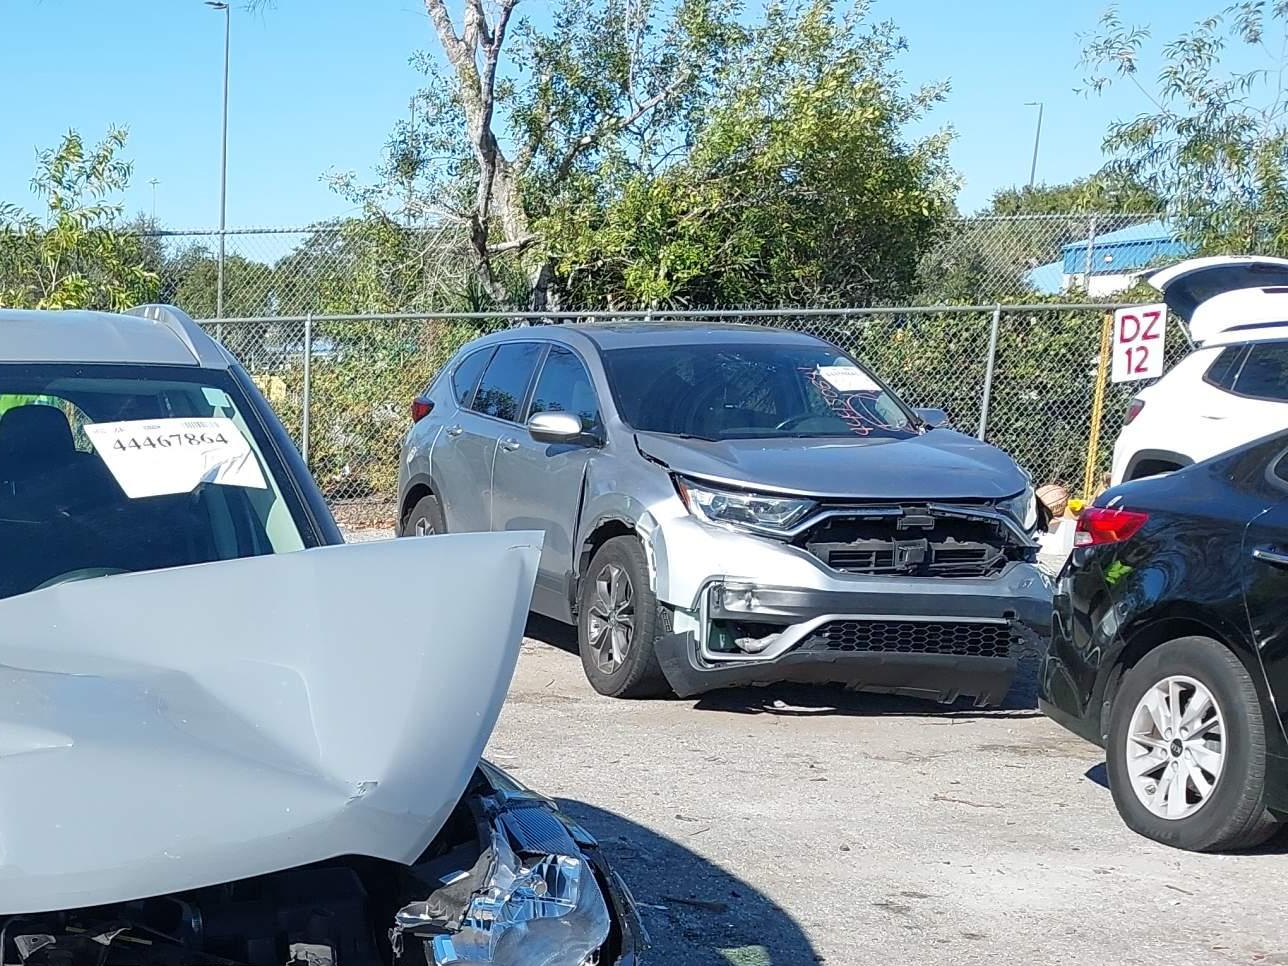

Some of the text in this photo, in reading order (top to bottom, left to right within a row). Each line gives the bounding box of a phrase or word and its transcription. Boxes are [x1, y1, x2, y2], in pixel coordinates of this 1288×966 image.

[1120, 311, 1161, 343] DZ
[1125, 346, 1149, 374] 12
[113, 433, 228, 451] 44467864
